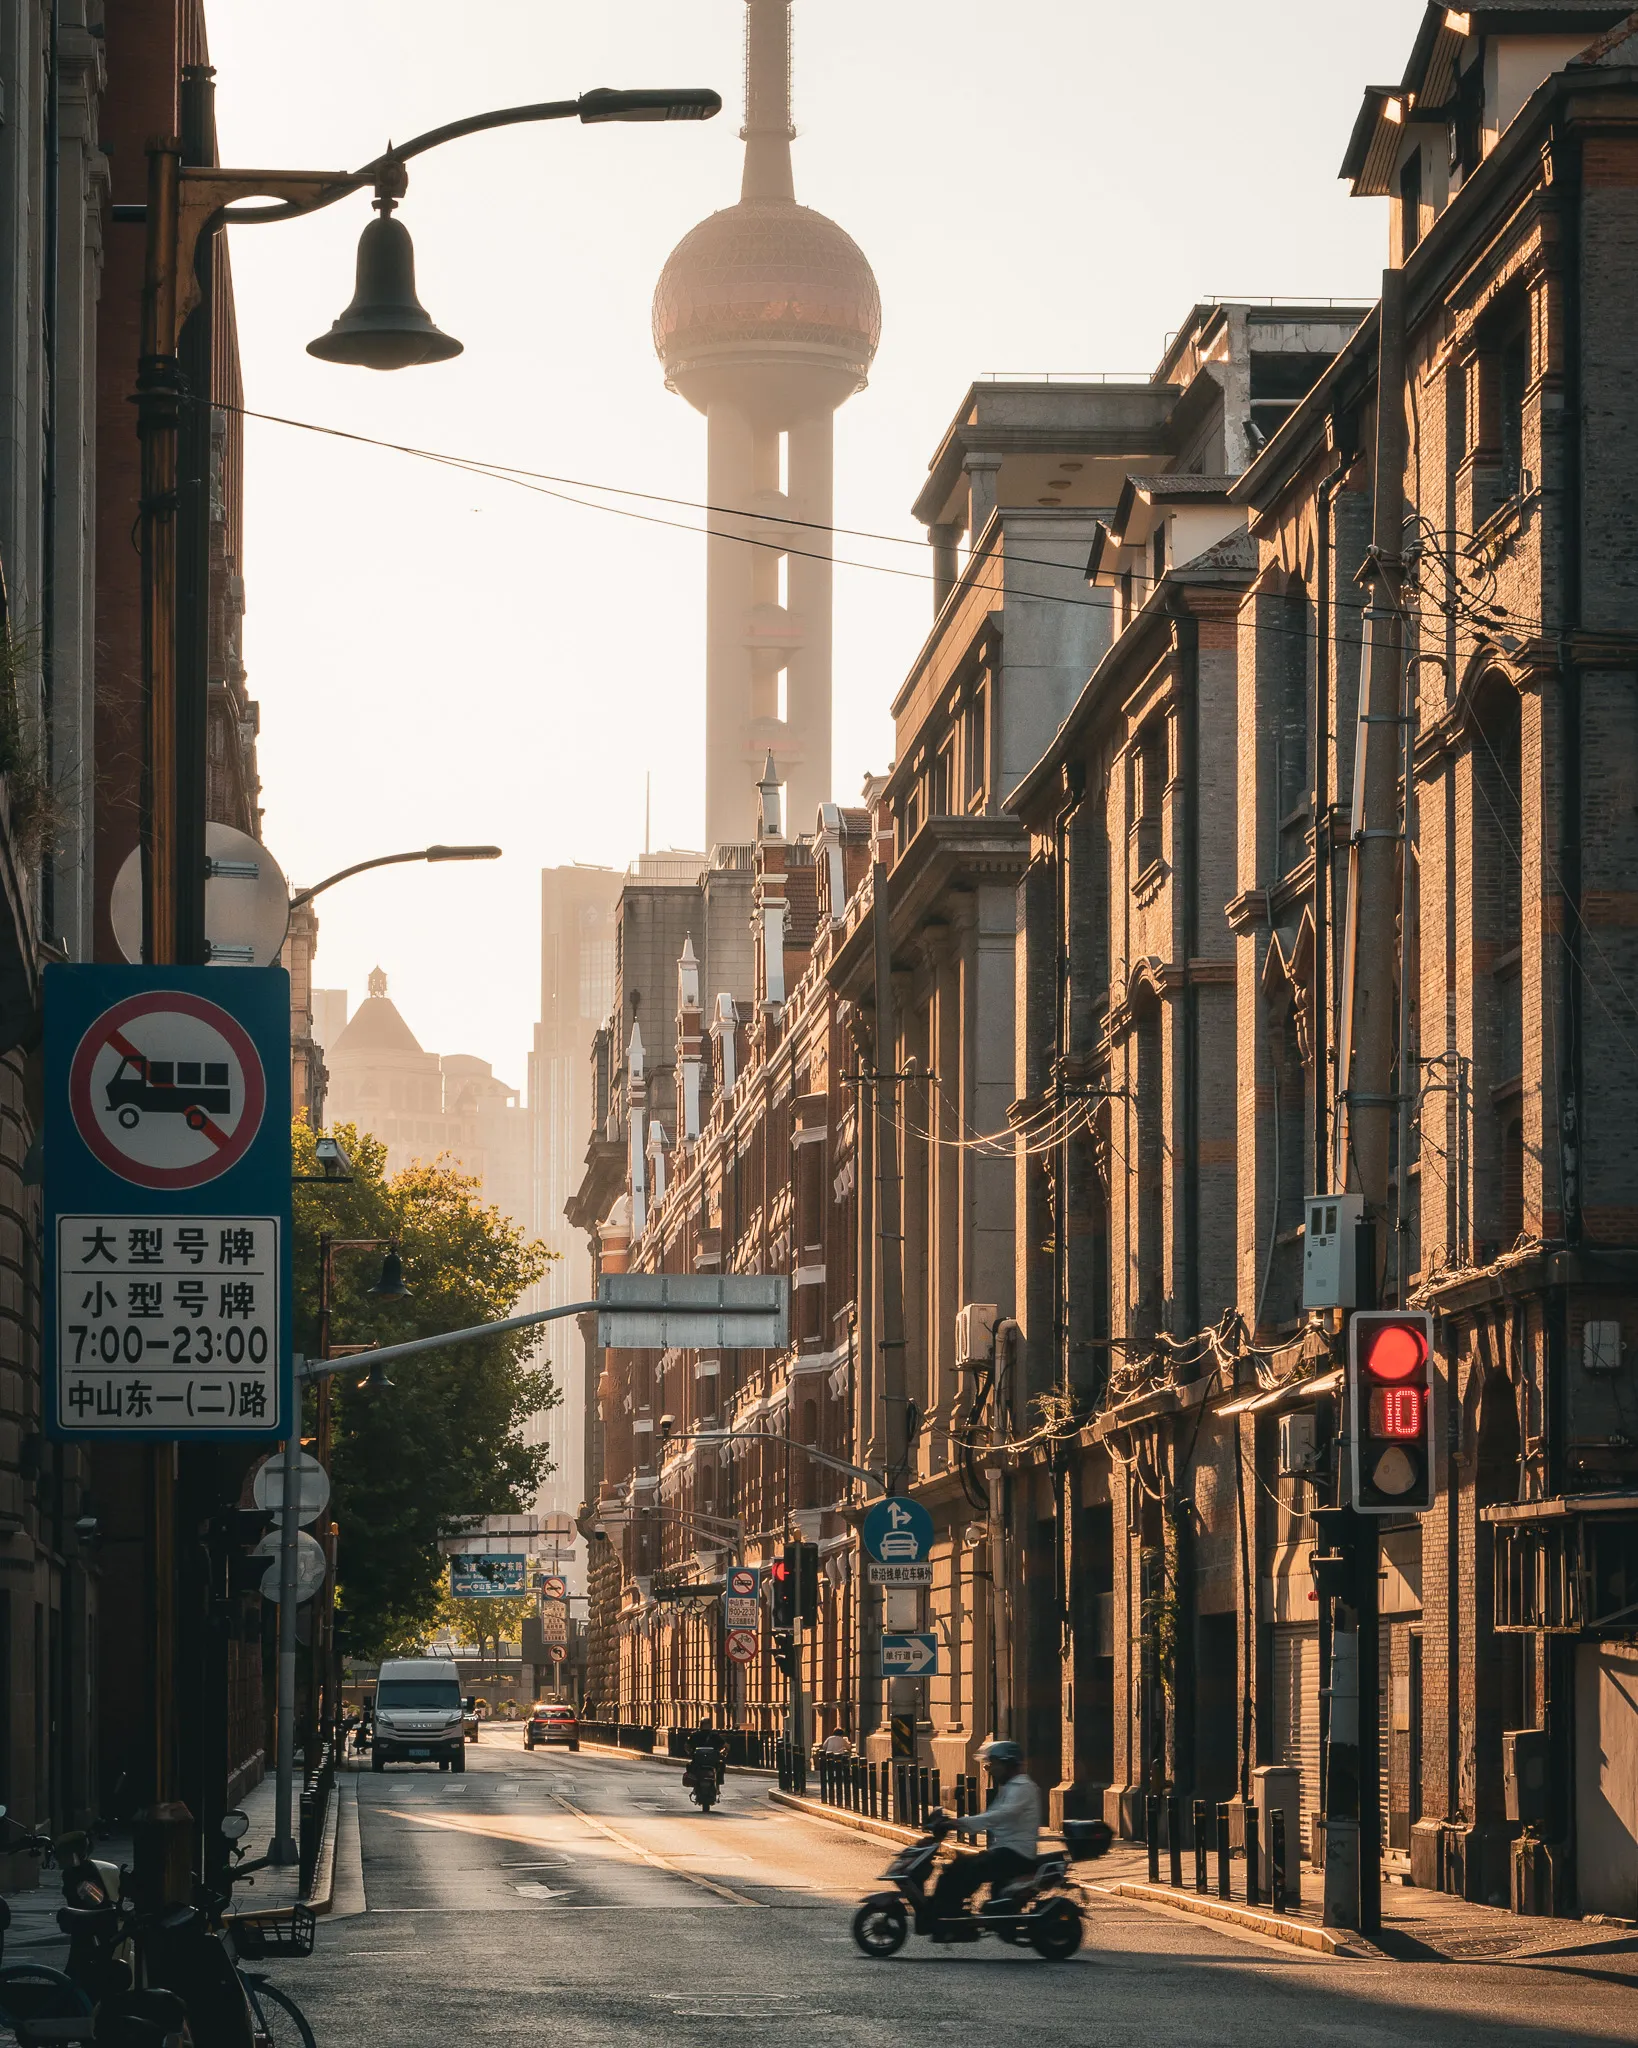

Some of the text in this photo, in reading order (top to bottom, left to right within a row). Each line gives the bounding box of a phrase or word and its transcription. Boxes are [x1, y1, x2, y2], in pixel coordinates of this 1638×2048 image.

[81, 1227, 255, 1266] 大型号牌
[81, 1281, 255, 1319] 小型号牌
[69, 1380, 268, 1418] 中山东一(二)路
[1386, 1390, 1418, 1433] 10
[871, 1566, 932, 1581] 除沿线单位车辆外
[728, 1599, 755, 1607] 中山东一路
[886, 1650, 910, 1660] 单行道
